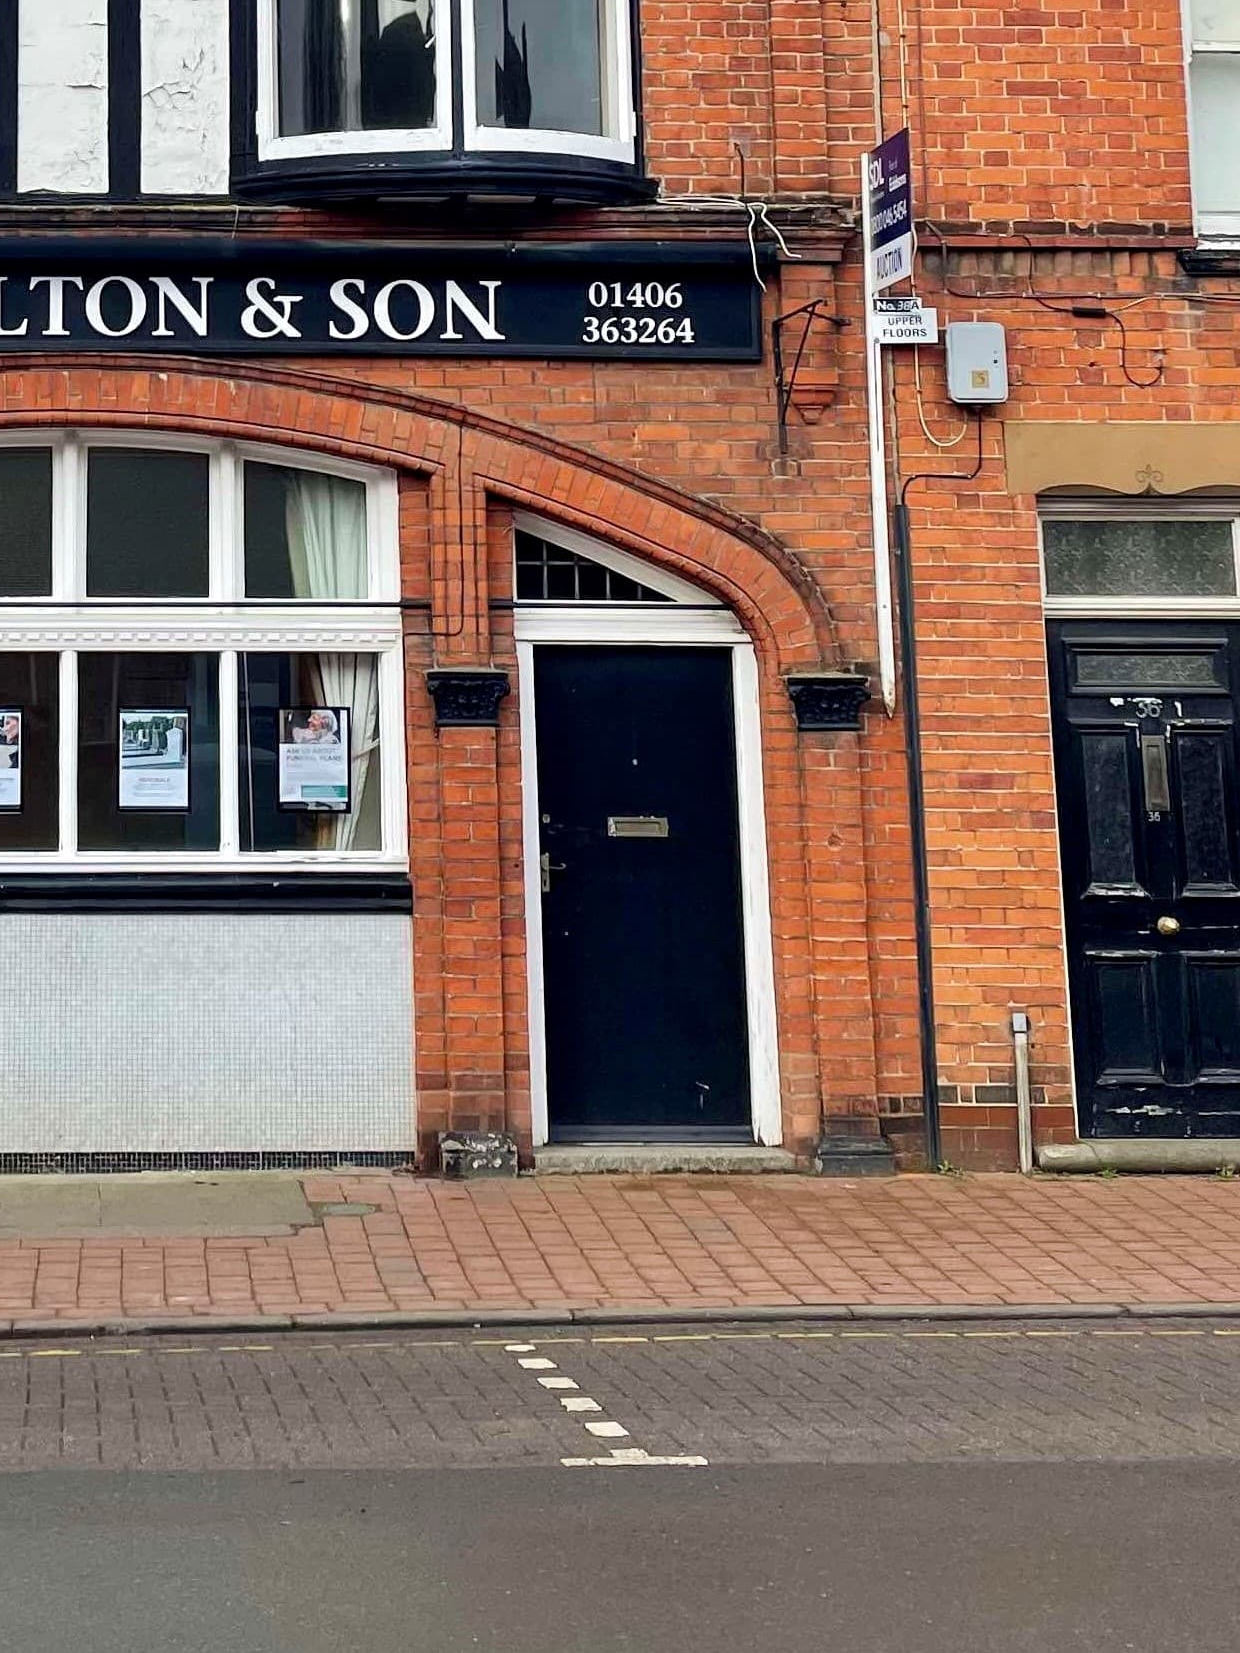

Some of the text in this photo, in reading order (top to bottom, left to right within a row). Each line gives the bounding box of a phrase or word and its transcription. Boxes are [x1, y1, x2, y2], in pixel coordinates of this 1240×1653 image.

[876, 248, 902, 280] AUCTION
[240, 277, 304, 338] &
[329, 278, 506, 341] SON
[588, 281, 683, 309] 01406
[582, 315, 695, 344] 363264
[883, 328, 927, 338] FLOORS
[887, 316, 922, 326] UPPER
